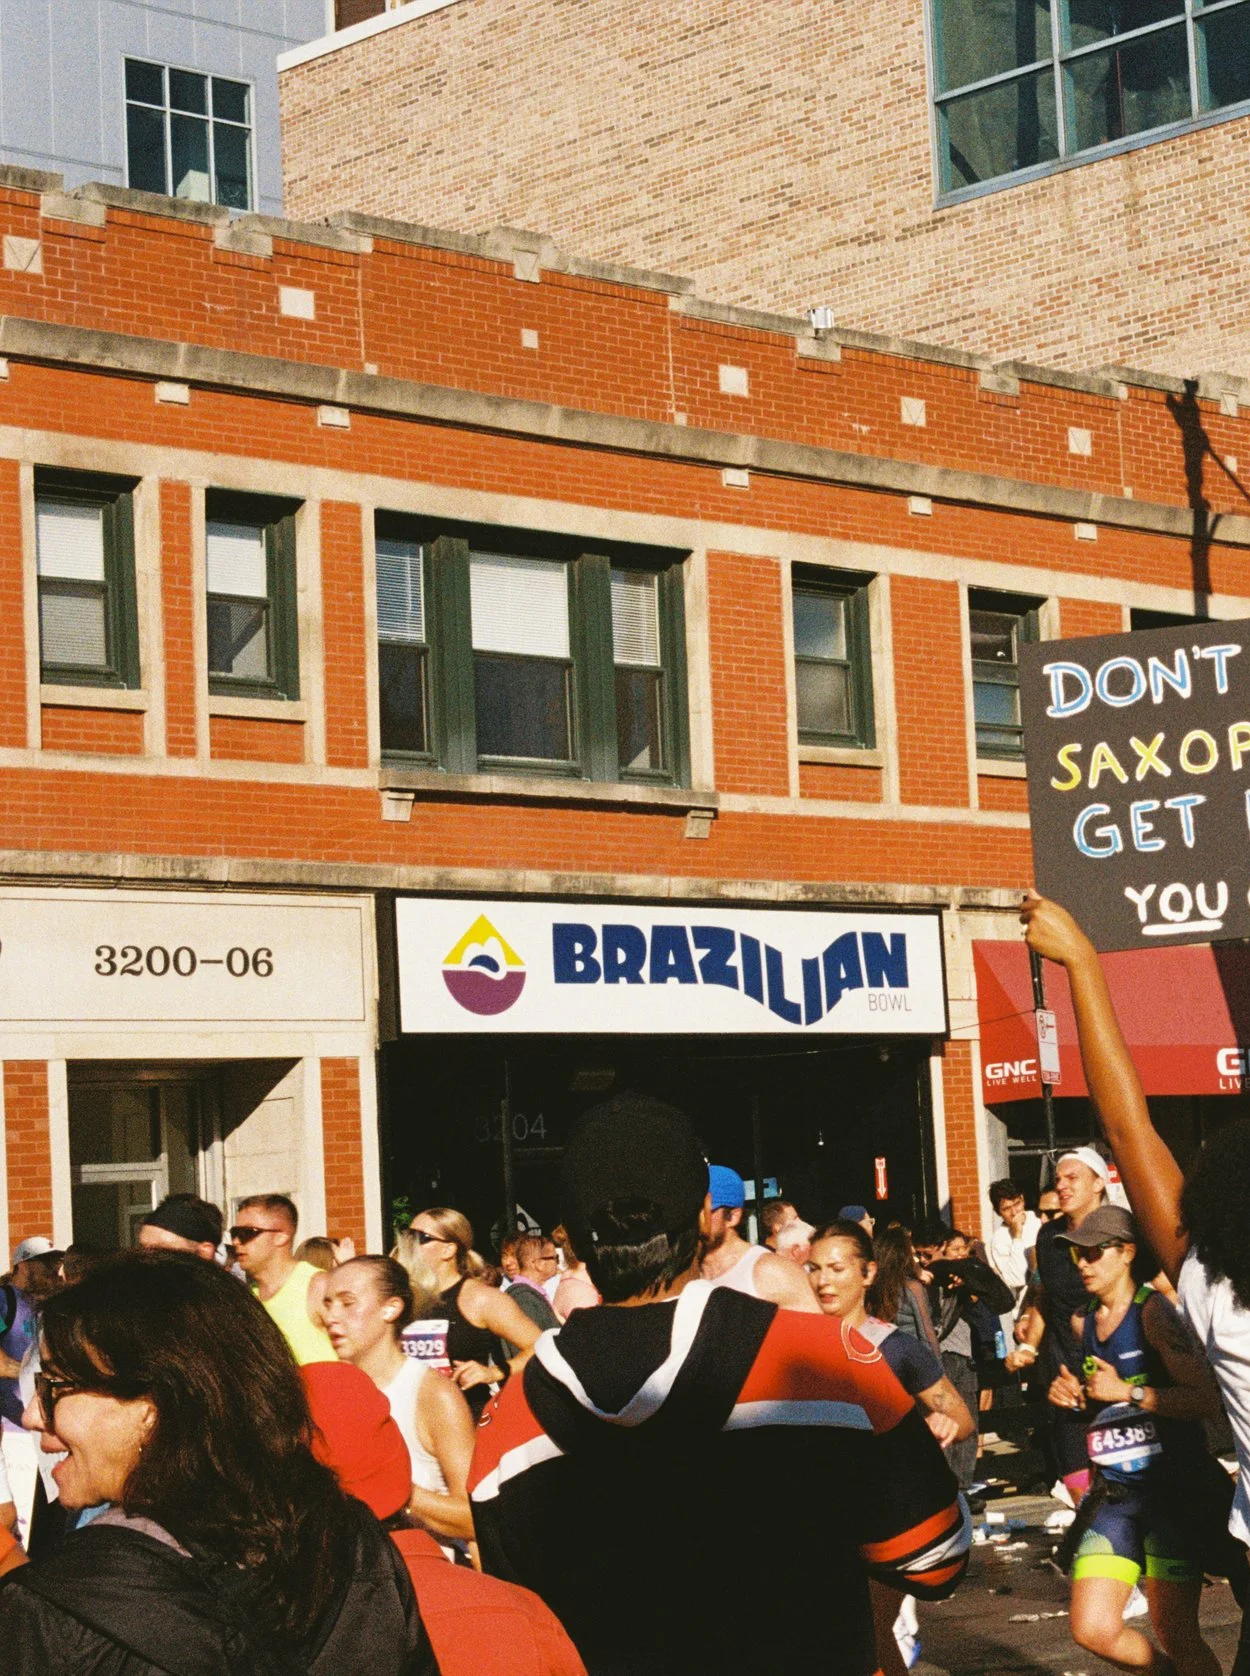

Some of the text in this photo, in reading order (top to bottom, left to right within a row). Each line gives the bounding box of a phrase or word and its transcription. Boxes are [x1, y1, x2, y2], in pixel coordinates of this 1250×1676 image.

[1042, 643, 1243, 718] DON'T
[1073, 792, 1208, 859] GET
[1123, 880, 1229, 924] YOU
[94, 944, 275, 978] 3200-06
[551, 922, 910, 1027] BRAZILIAN
[867, 993, 913, 1013] BOWL
[985, 1058, 1037, 1080] GNC
[986, 1078, 1007, 1087] LIVE
[1012, 1075, 1037, 1084] WELL
